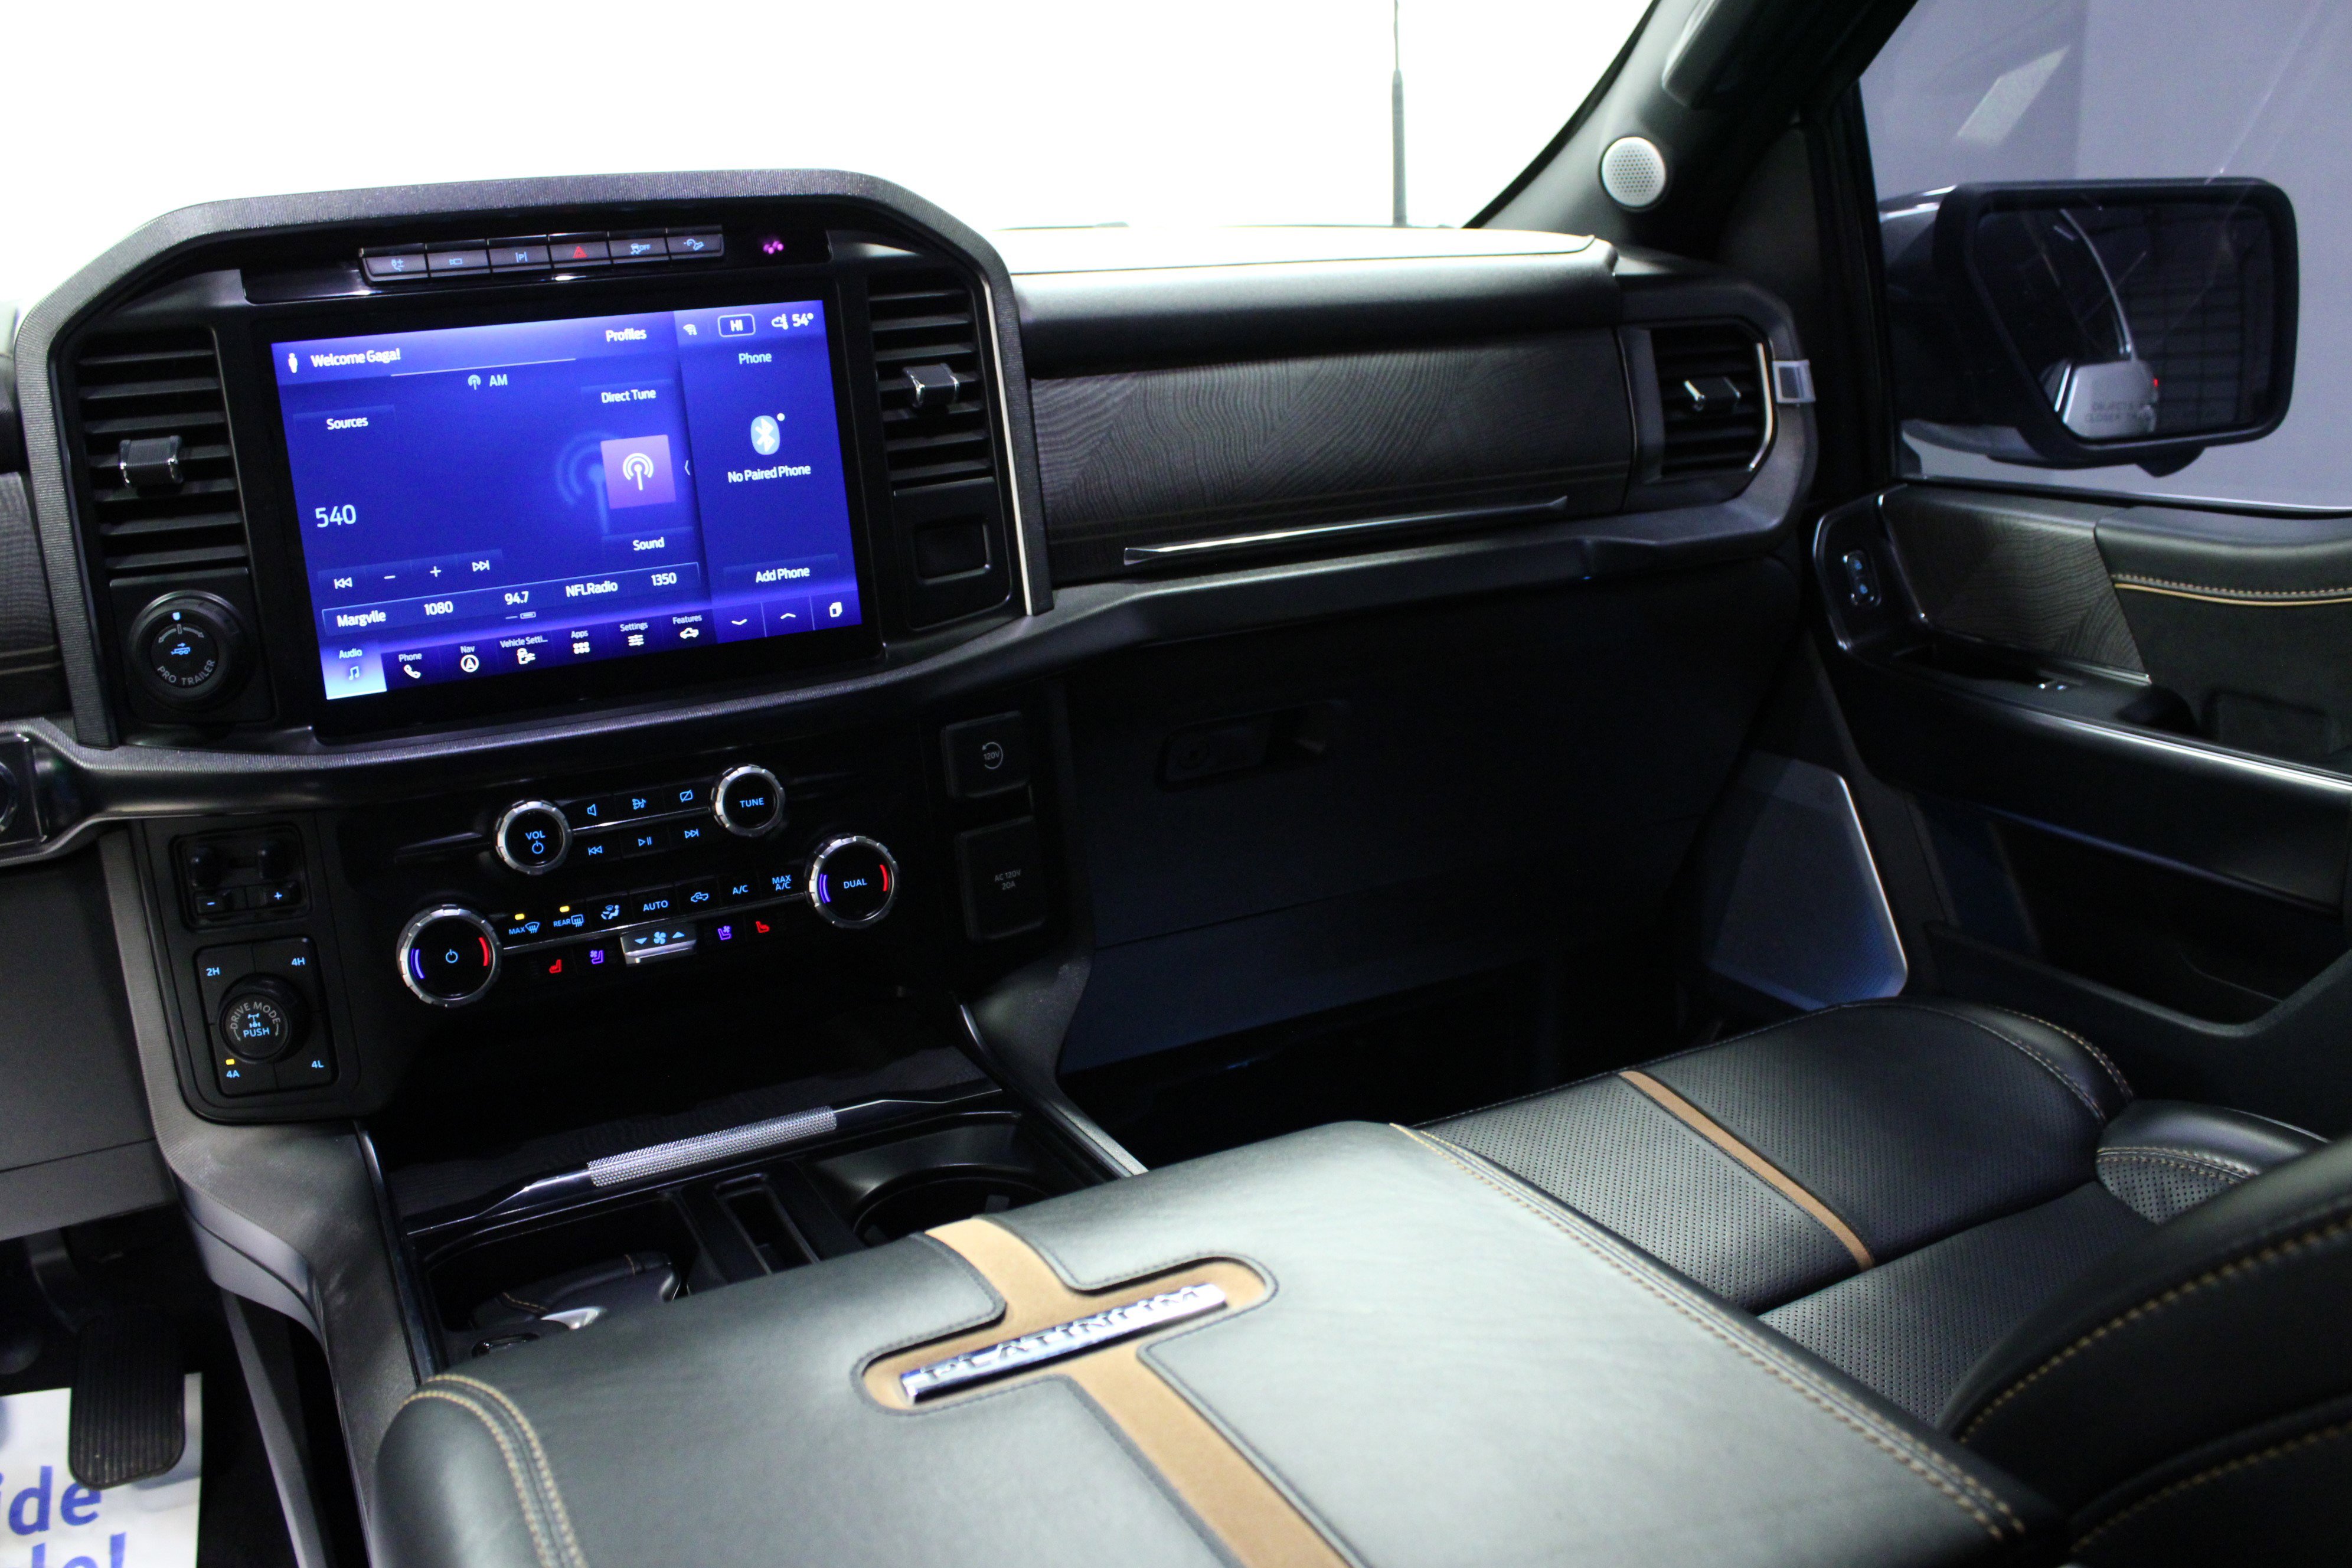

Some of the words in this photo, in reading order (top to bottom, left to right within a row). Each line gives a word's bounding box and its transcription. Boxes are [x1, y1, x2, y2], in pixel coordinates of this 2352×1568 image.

[730, 319, 743, 332] HI
[792, 312, 814, 327] 54°
[606, 328, 647, 342] Profiles
[311, 352, 365, 368] Welcome
[366, 348, 401, 364] Gaga!
[739, 352, 772, 364] Phone
[489, 374, 508, 387] AM
[601, 390, 630, 403] Direct
[631, 388, 656, 401] Tune
[326, 417, 368, 431] Sources
[727, 471, 743, 483] No
[744, 466, 777, 481] Paired
[778, 464, 811, 478] Phone
[315, 504, 357, 528] 540
[633, 537, 665, 551] Sound
[651, 572, 677, 586] 1350
[755, 570, 776, 583] Add
[777, 566, 810, 580] Phone
[504, 591, 529, 605] 94.7
[424, 600, 453, 616] 1080
[672, 614, 702, 625] Features
[620, 620, 648, 632] Settings
[571, 629, 588, 639] Apps
[499, 638, 525, 648] Vehicle
[338, 648, 362, 660] Audio
[460, 645, 475, 654] Nav
[398, 652, 422, 662] Phone
[157, 665, 177, 684] PRO
[181, 659, 215, 685] TRAILER
[984, 751, 1000, 760] 120V
[739, 798, 765, 808] TUNE
[525, 830, 545, 840] VOL
[772, 874, 792, 885] MAX
[994, 873, 1004, 881] AC
[1005, 869, 1021, 878] 120V
[775, 882, 792, 891] A/C
[843, 878, 867, 889] DUAL
[732, 885, 749, 895] A/C
[643, 900, 669, 912] AUTO
[553, 918, 571, 927] REAR
[508, 926, 525, 935] MAX
[291, 957, 306, 966] 4H
[206, 967, 220, 976] 2H
[230, 1002, 251, 1030] DRIVE
[254, 1001, 281, 1025] MODE
[243, 1028, 270, 1038] PUSH
[311, 1060, 324, 1069] 4L
[226, 1070, 240, 1079] 4A
[0, 1466, 102, 1536] de
